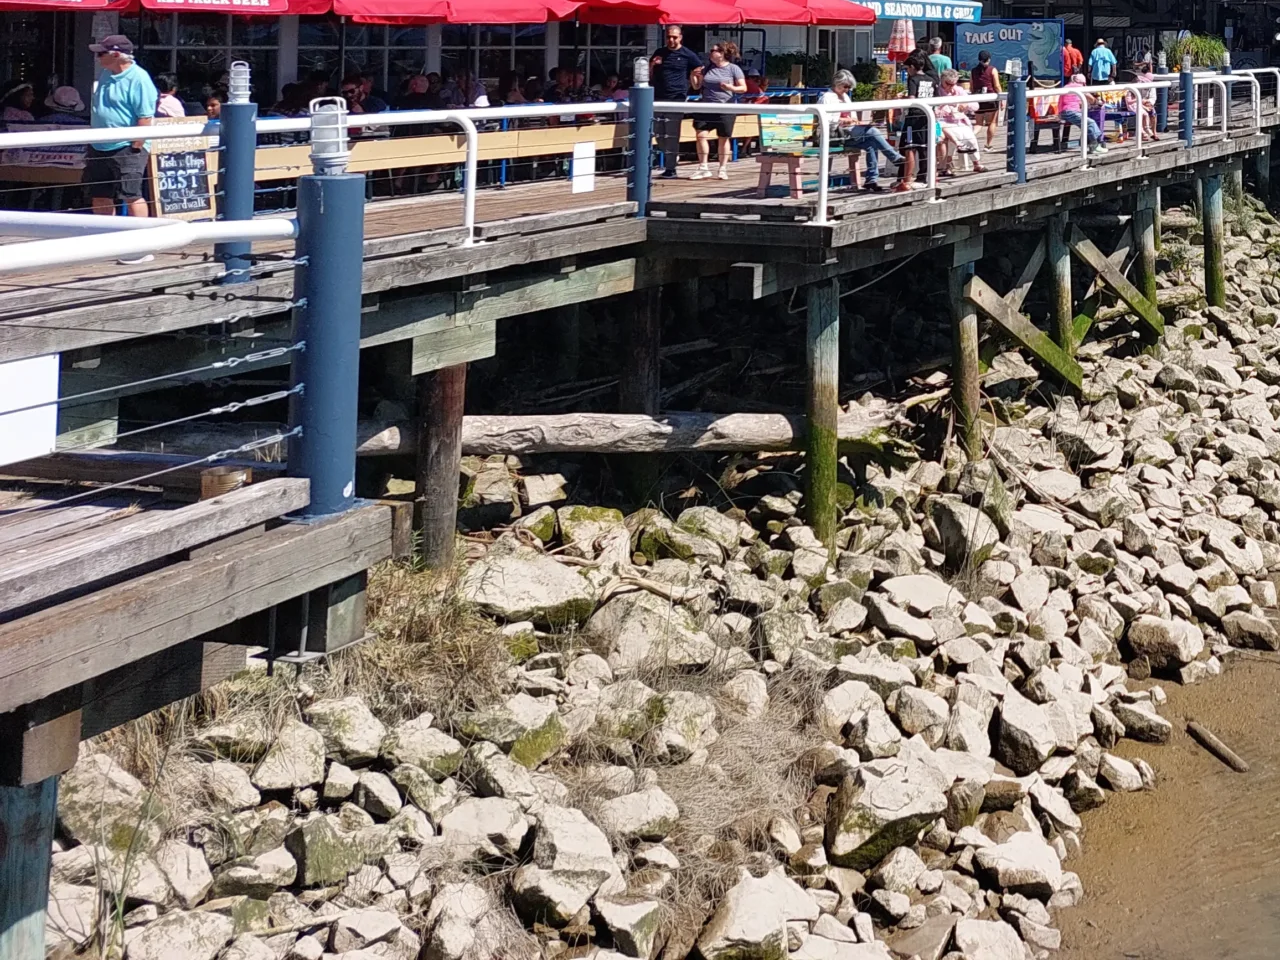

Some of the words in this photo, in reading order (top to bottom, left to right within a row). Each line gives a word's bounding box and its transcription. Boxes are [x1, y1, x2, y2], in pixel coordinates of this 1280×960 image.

[884, 1, 924, 18] SEAFOOD
[925, 4, 943, 19] BAR
[964, 31, 995, 44] TAKE
[998, 28, 1024, 42] OUT
[184, 155, 205, 168] Chips
[157, 168, 200, 190] BEST
[164, 198, 207, 212] boardwalk
